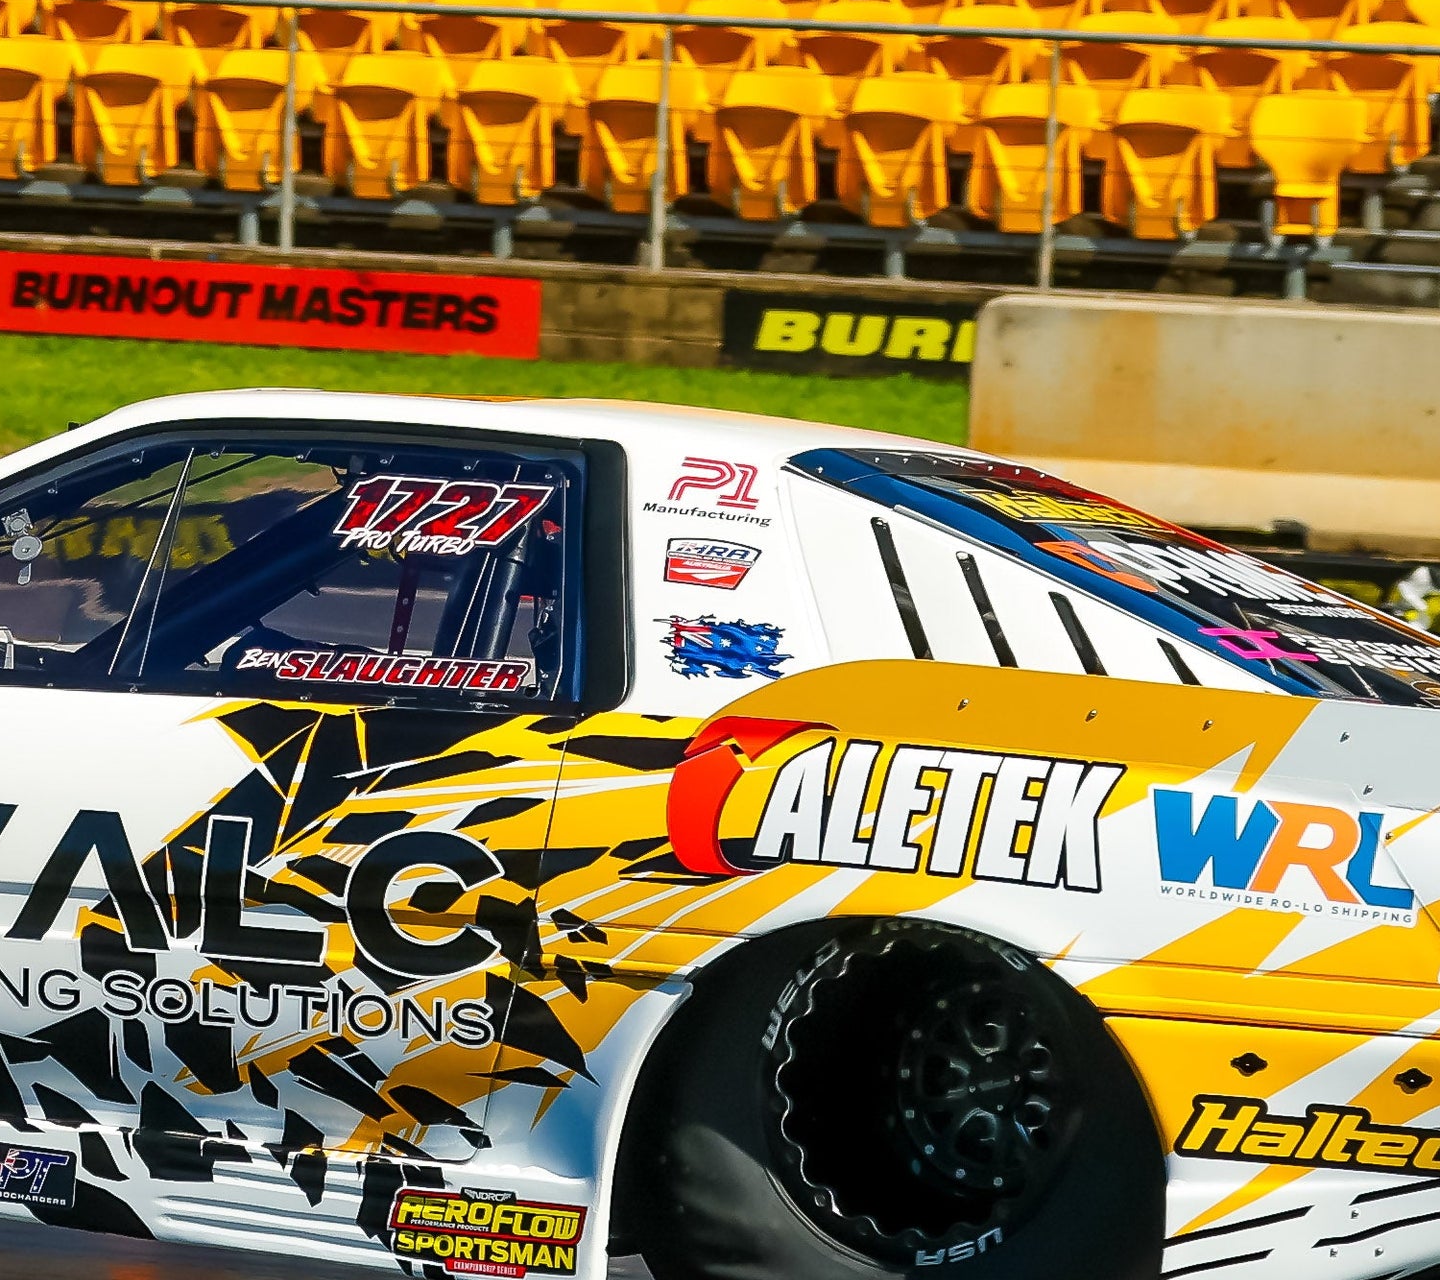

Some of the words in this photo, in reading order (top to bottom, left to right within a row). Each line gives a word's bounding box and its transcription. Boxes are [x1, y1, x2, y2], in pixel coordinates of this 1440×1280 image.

[11, 270, 254, 320] BURNOUT
[262, 282, 500, 335] MASTERS
[333, 474, 554, 546] 1727
[642, 502, 773, 528] Manufacturing
[341, 527, 393, 550] PRO
[396, 530, 477, 557] TURBO
[237, 648, 290, 670] BEN
[275, 650, 532, 692] SLAUGHTER
[1153, 788, 1415, 910] WRL
[1160, 884, 1264, 906] WORLDWIDE
[1270, 898, 1323, 914] RO-LO
[1331, 906, 1413, 924] SHIPPING
[100, 967, 497, 1047] SOLUTIONS
[397, 1195, 581, 1240] AEROFLOW
[410, 1219, 455, 1229] PERFORMANCE
[397, 1231, 574, 1270] SPORTSMAN
